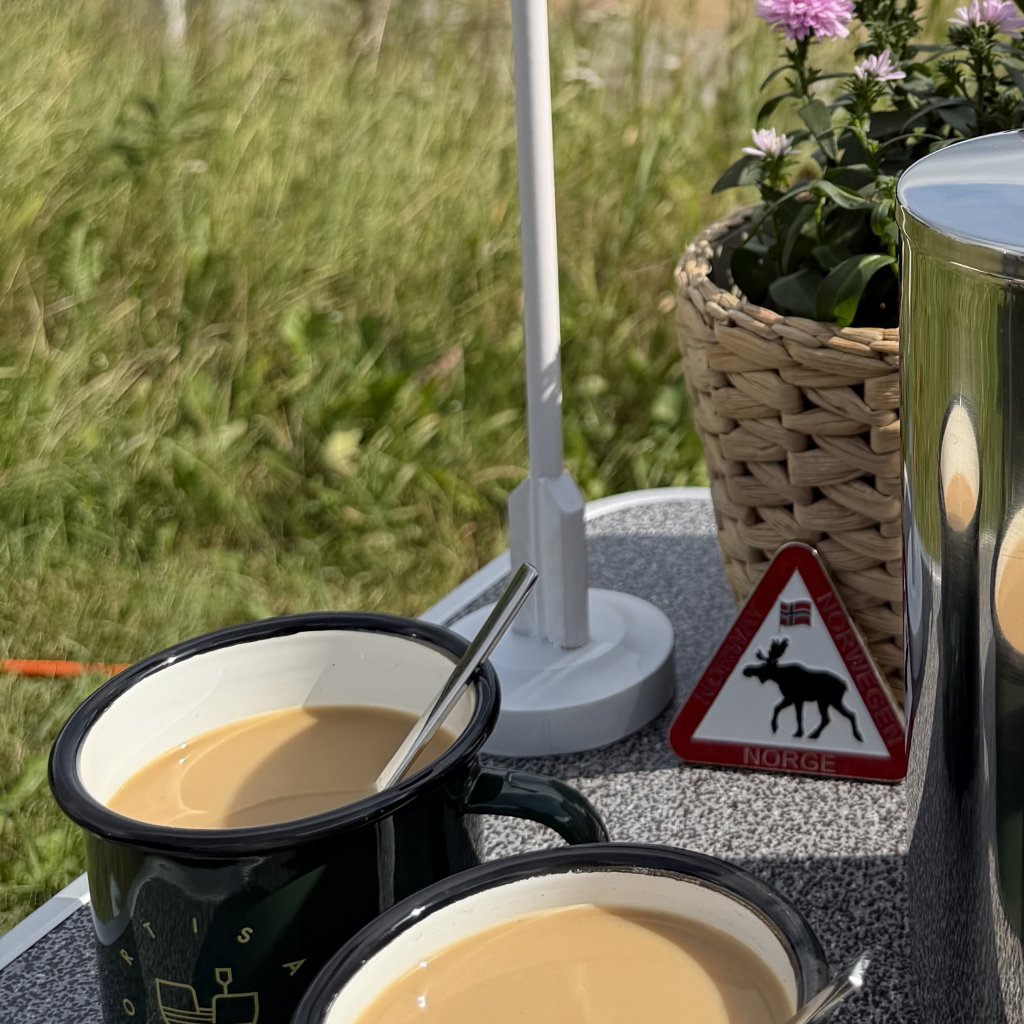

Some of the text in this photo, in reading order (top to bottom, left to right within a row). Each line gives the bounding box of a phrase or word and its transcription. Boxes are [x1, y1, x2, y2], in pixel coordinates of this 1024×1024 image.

[695, 603, 763, 706] NORWAY
[816, 591, 901, 747] NORWEGEN
[742, 745, 837, 773] NORGE
